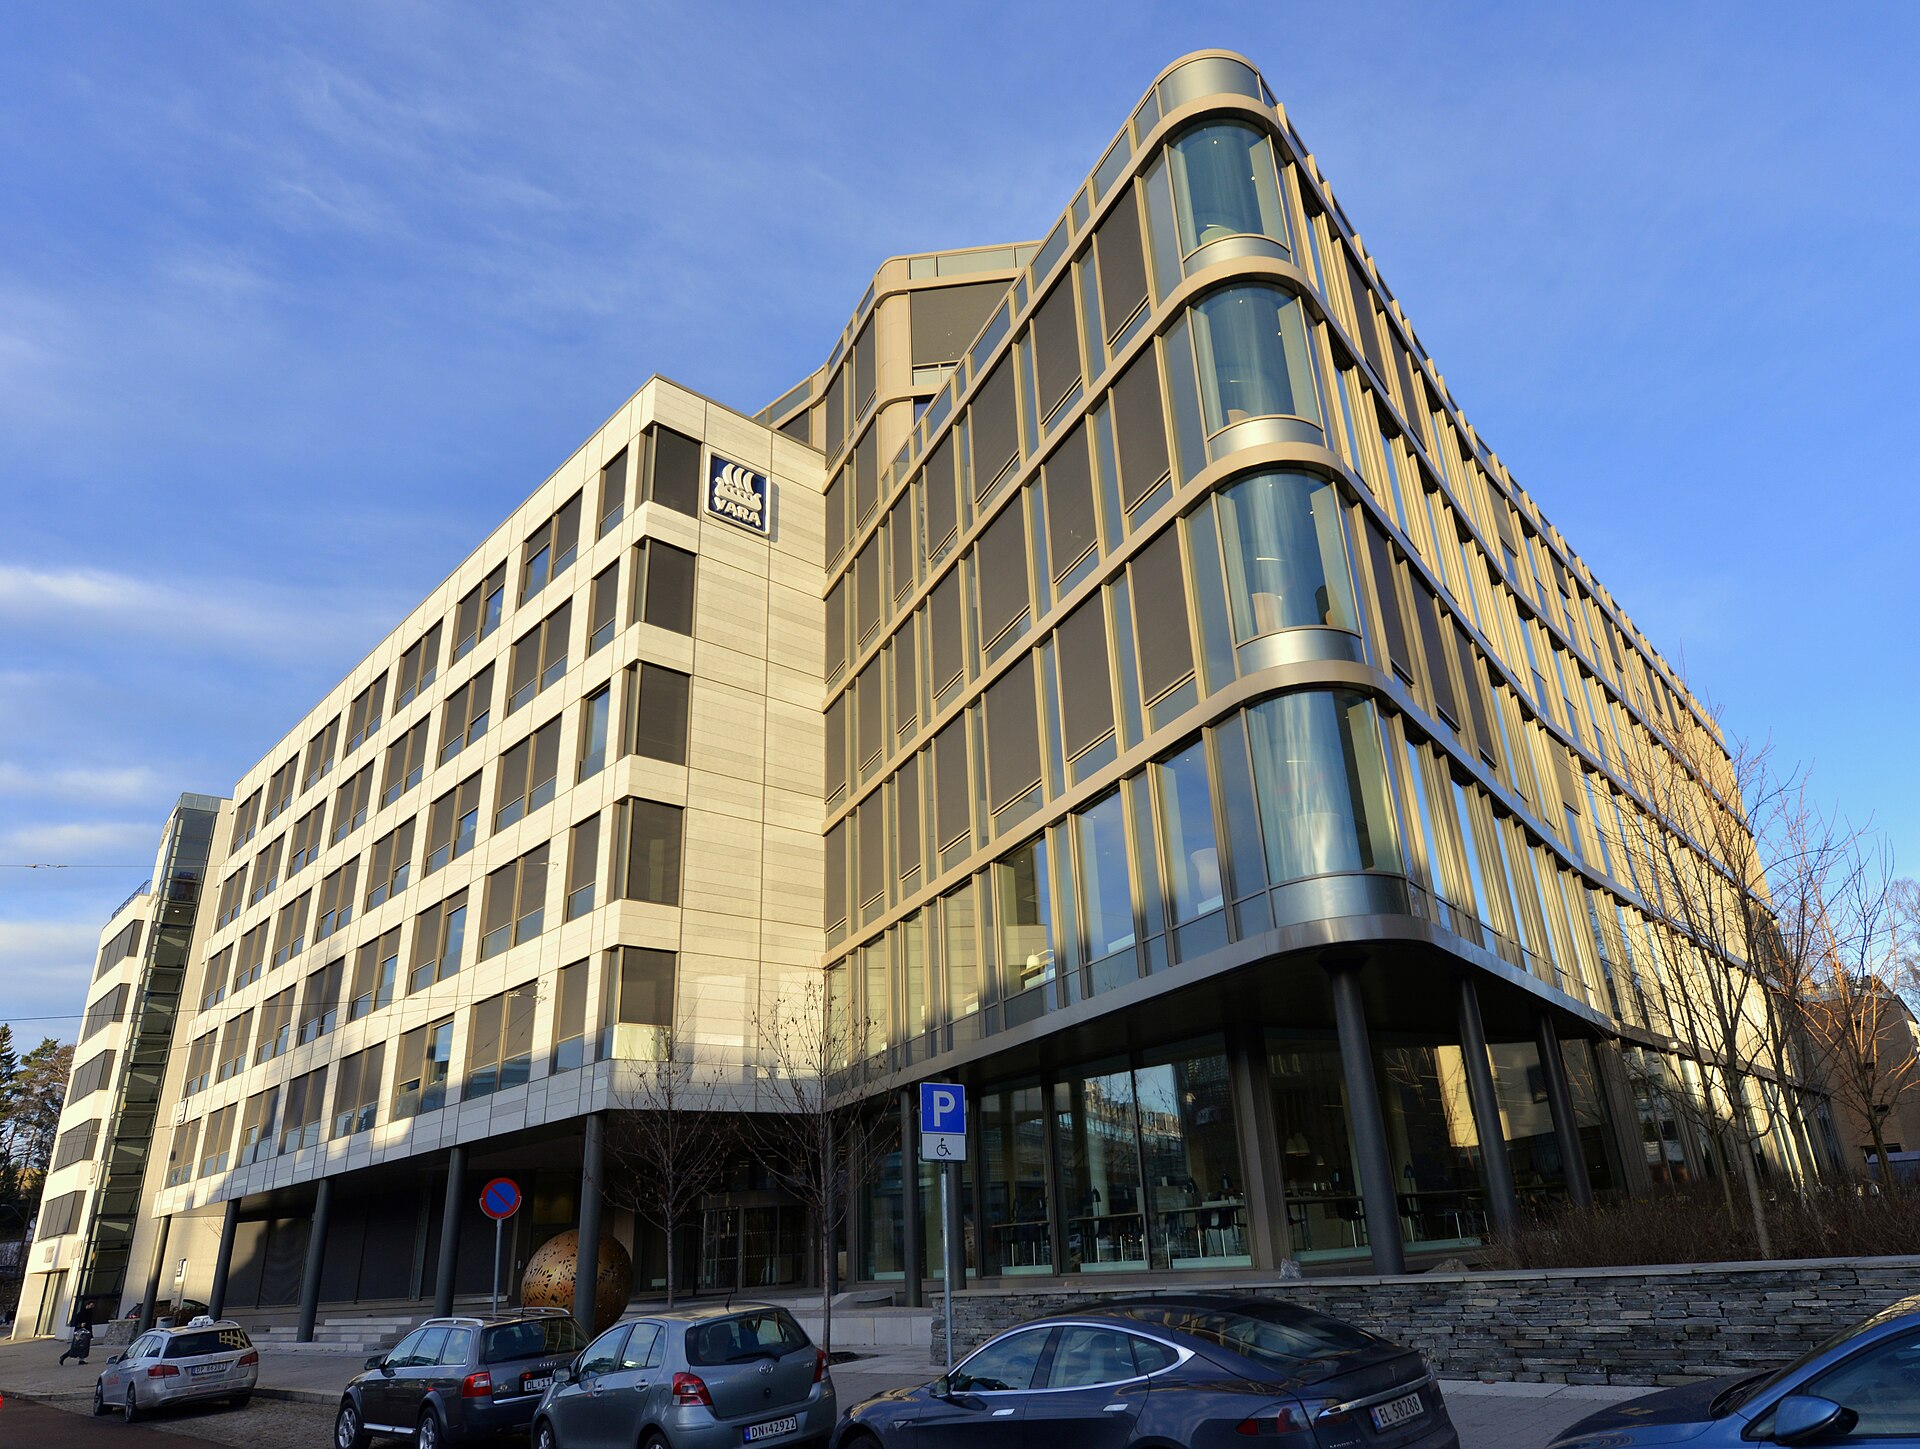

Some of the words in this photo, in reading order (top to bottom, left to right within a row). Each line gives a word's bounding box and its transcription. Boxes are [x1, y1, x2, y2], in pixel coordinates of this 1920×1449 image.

[933, 1090, 955, 1127] P
[1378, 1407, 1392, 1424] EL
[1391, 1396, 1420, 1419] 58288
[752, 1426, 764, 1438] DN
[768, 1419, 795, 1433] 42922
